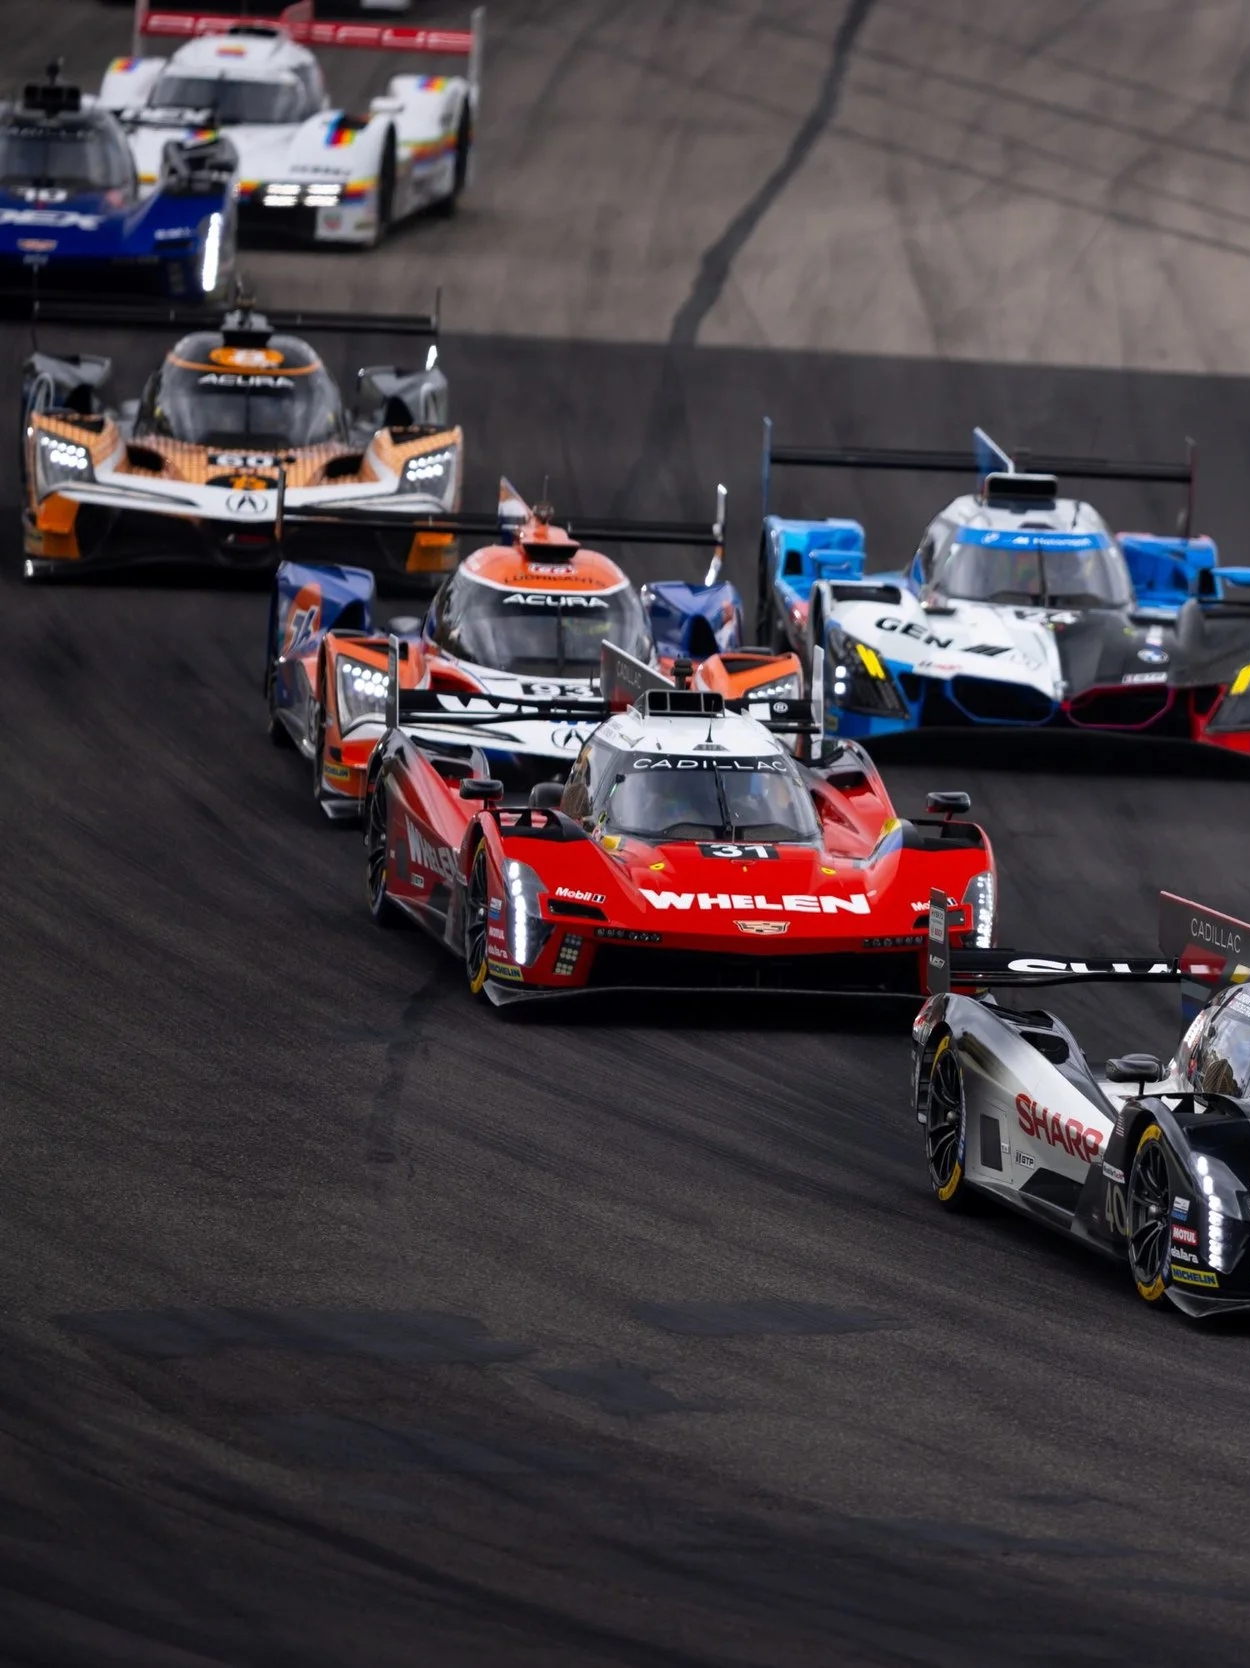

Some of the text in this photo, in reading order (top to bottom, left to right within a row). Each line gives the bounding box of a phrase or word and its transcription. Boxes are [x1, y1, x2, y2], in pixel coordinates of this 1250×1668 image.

[198, 373, 294, 389] ACURA
[217, 454, 274, 468] 60
[503, 593, 609, 608] ACURA
[875, 616, 954, 649] GEN
[531, 683, 594, 697] 93
[633, 758, 788, 772] CADILLAC
[711, 845, 769, 859] 31
[555, 886, 592, 900] Mobil
[639, 888, 871, 914] WHELEN
[1190, 918, 1241, 954] CADILLAC
[1015, 1093, 1104, 1164] SHARP
[1105, 1181, 1133, 1237] 40
[1172, 1227, 1197, 1243] MOTUL
[1174, 1269, 1214, 1283] MICHELIN
